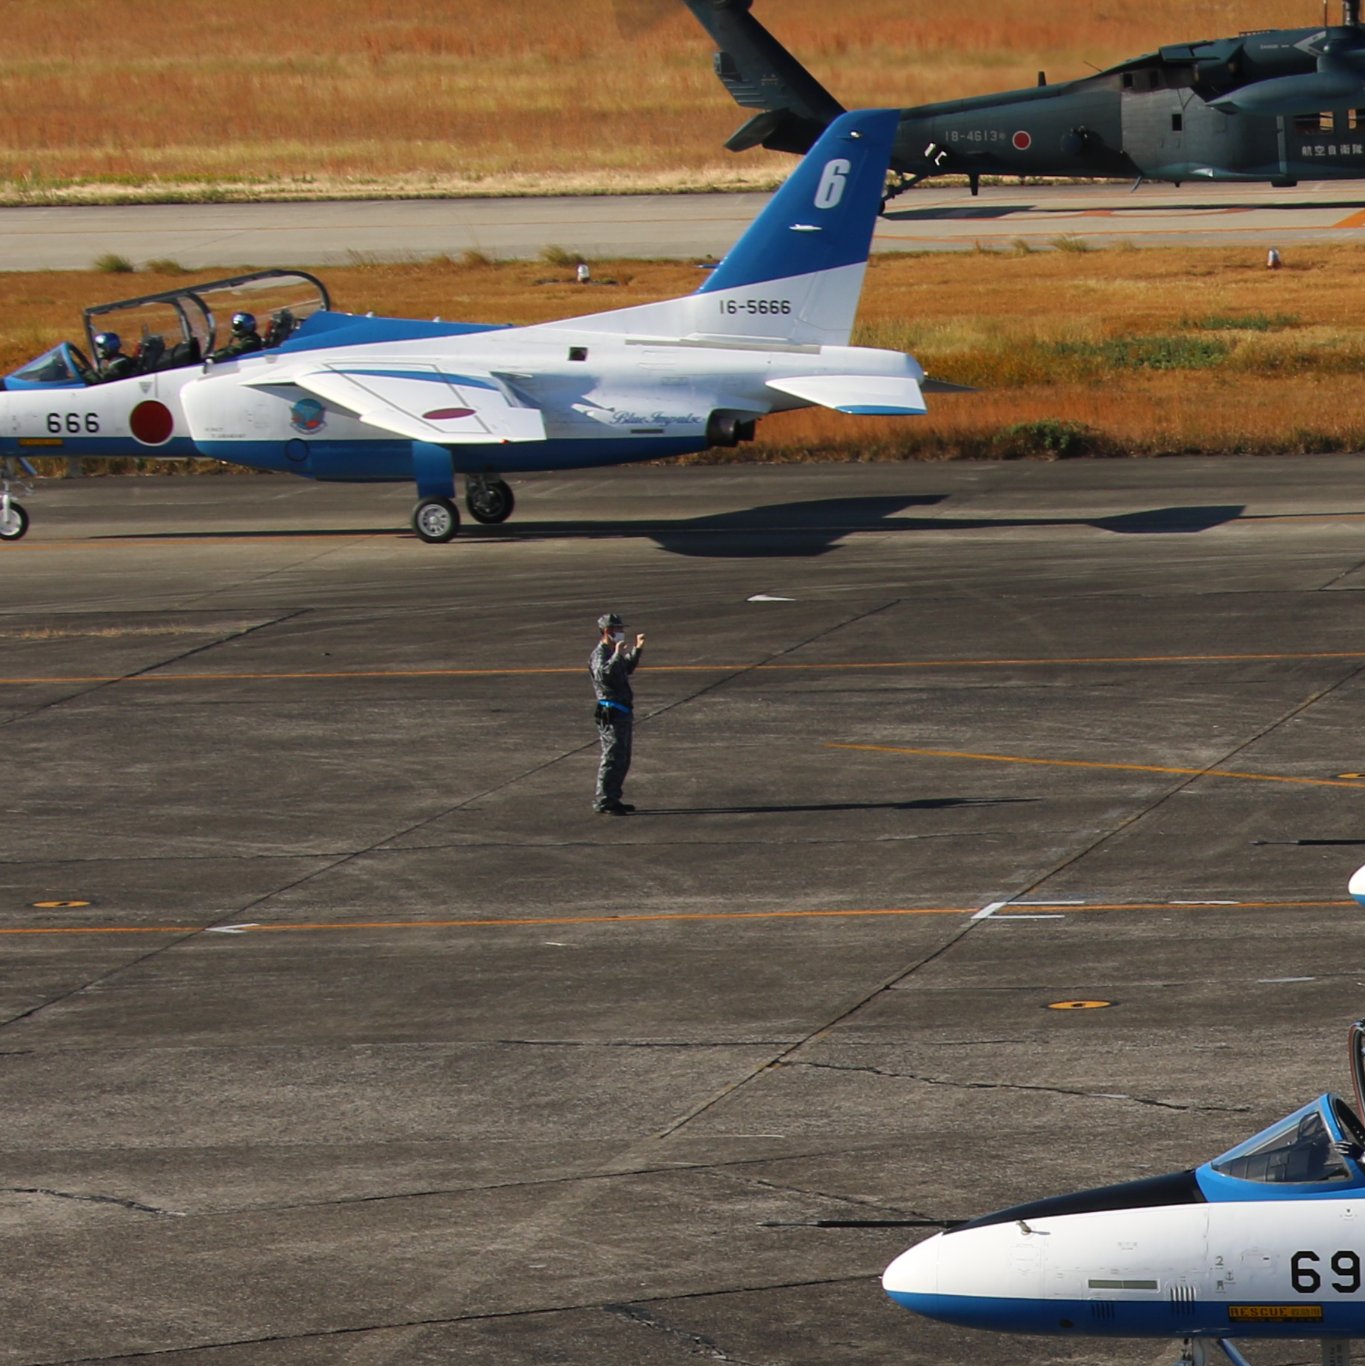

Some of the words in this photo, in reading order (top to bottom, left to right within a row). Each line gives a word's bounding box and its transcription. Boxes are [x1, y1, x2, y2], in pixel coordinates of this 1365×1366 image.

[813, 158, 851, 209] 6
[719, 299, 791, 314] 16-5666
[47, 412, 99, 433] 666
[1230, 1307, 1288, 1317] RESCUE
